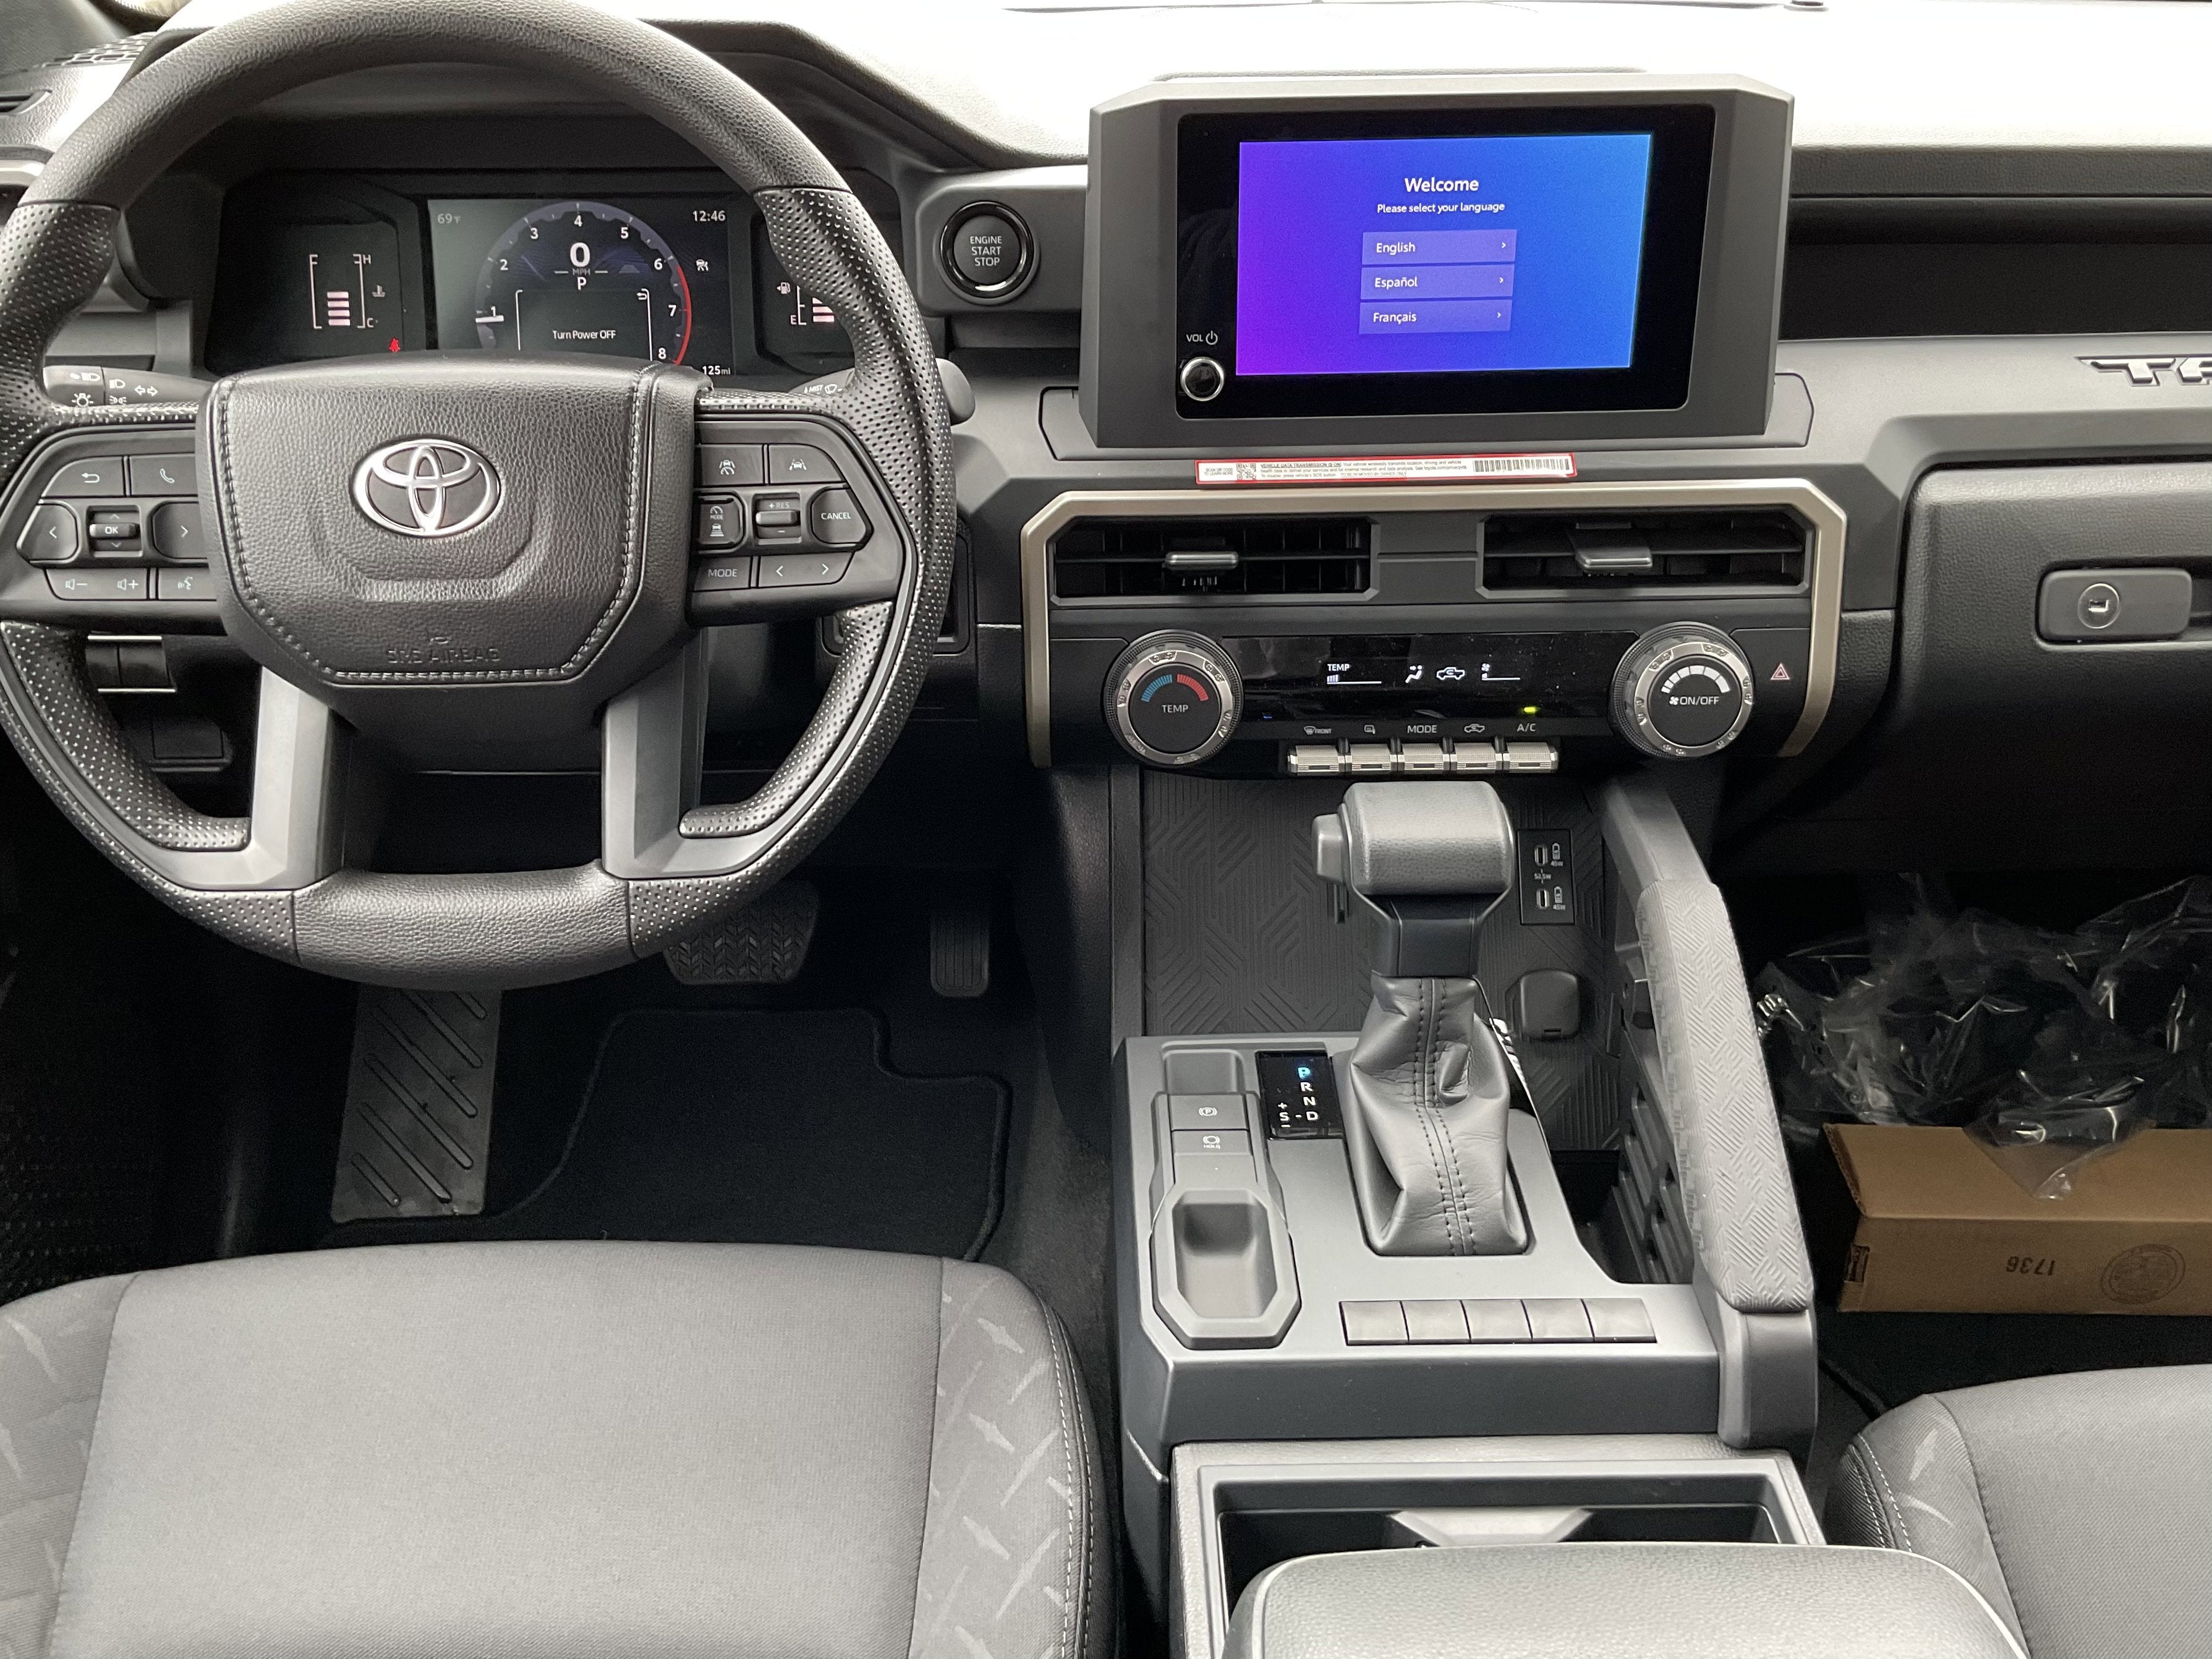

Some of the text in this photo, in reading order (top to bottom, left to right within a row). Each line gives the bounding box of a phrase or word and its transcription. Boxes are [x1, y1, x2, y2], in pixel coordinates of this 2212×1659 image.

[1405, 177, 1479, 192] Welcome
[1377, 203, 1505, 214] Please select your language
[574, 215, 583, 228] 4
[693, 210, 726, 223] 12:46
[530, 228, 539, 240] 3
[621, 227, 629, 239] 5
[969, 236, 1003, 245] ENGINE
[971, 245, 1002, 257] START
[1376, 242, 1416, 255] English
[362, 254, 371, 264] H
[570, 242, 590, 267] 0
[500, 258, 508, 271] 2
[653, 258, 663, 270] 6
[974, 256, 1001, 267] STOP
[572, 267, 591, 276] MPH
[577, 277, 587, 291] P
[1374, 276, 1418, 289] Español
[491, 305, 497, 317] 1
[668, 305, 677, 317] 7
[367, 318, 374, 328] C
[791, 315, 797, 325] E
[1373, 312, 1416, 324] Français
[553, 330, 616, 340] Turn Power OFF
[1186, 334, 1203, 342] VOL
[658, 348, 666, 360] 8
[821, 512, 851, 520] CANCEL
[105, 526, 118, 534] OK
[708, 568, 738, 578] MODE
[1327, 663, 1350, 672] TEMP
[1680, 696, 1719, 706] ON/OFF
[1162, 704, 1189, 713] TEMP
[1407, 725, 1437, 735] MODE
[1516, 723, 1536, 733] A/C
[1298, 1067, 1311, 1078] P
[1300, 1082, 1313, 1092] R
[1303, 1096, 1316, 1106] N
[1306, 1111, 1319, 1120] D
[2006, 1256, 2056, 1276] 1736
